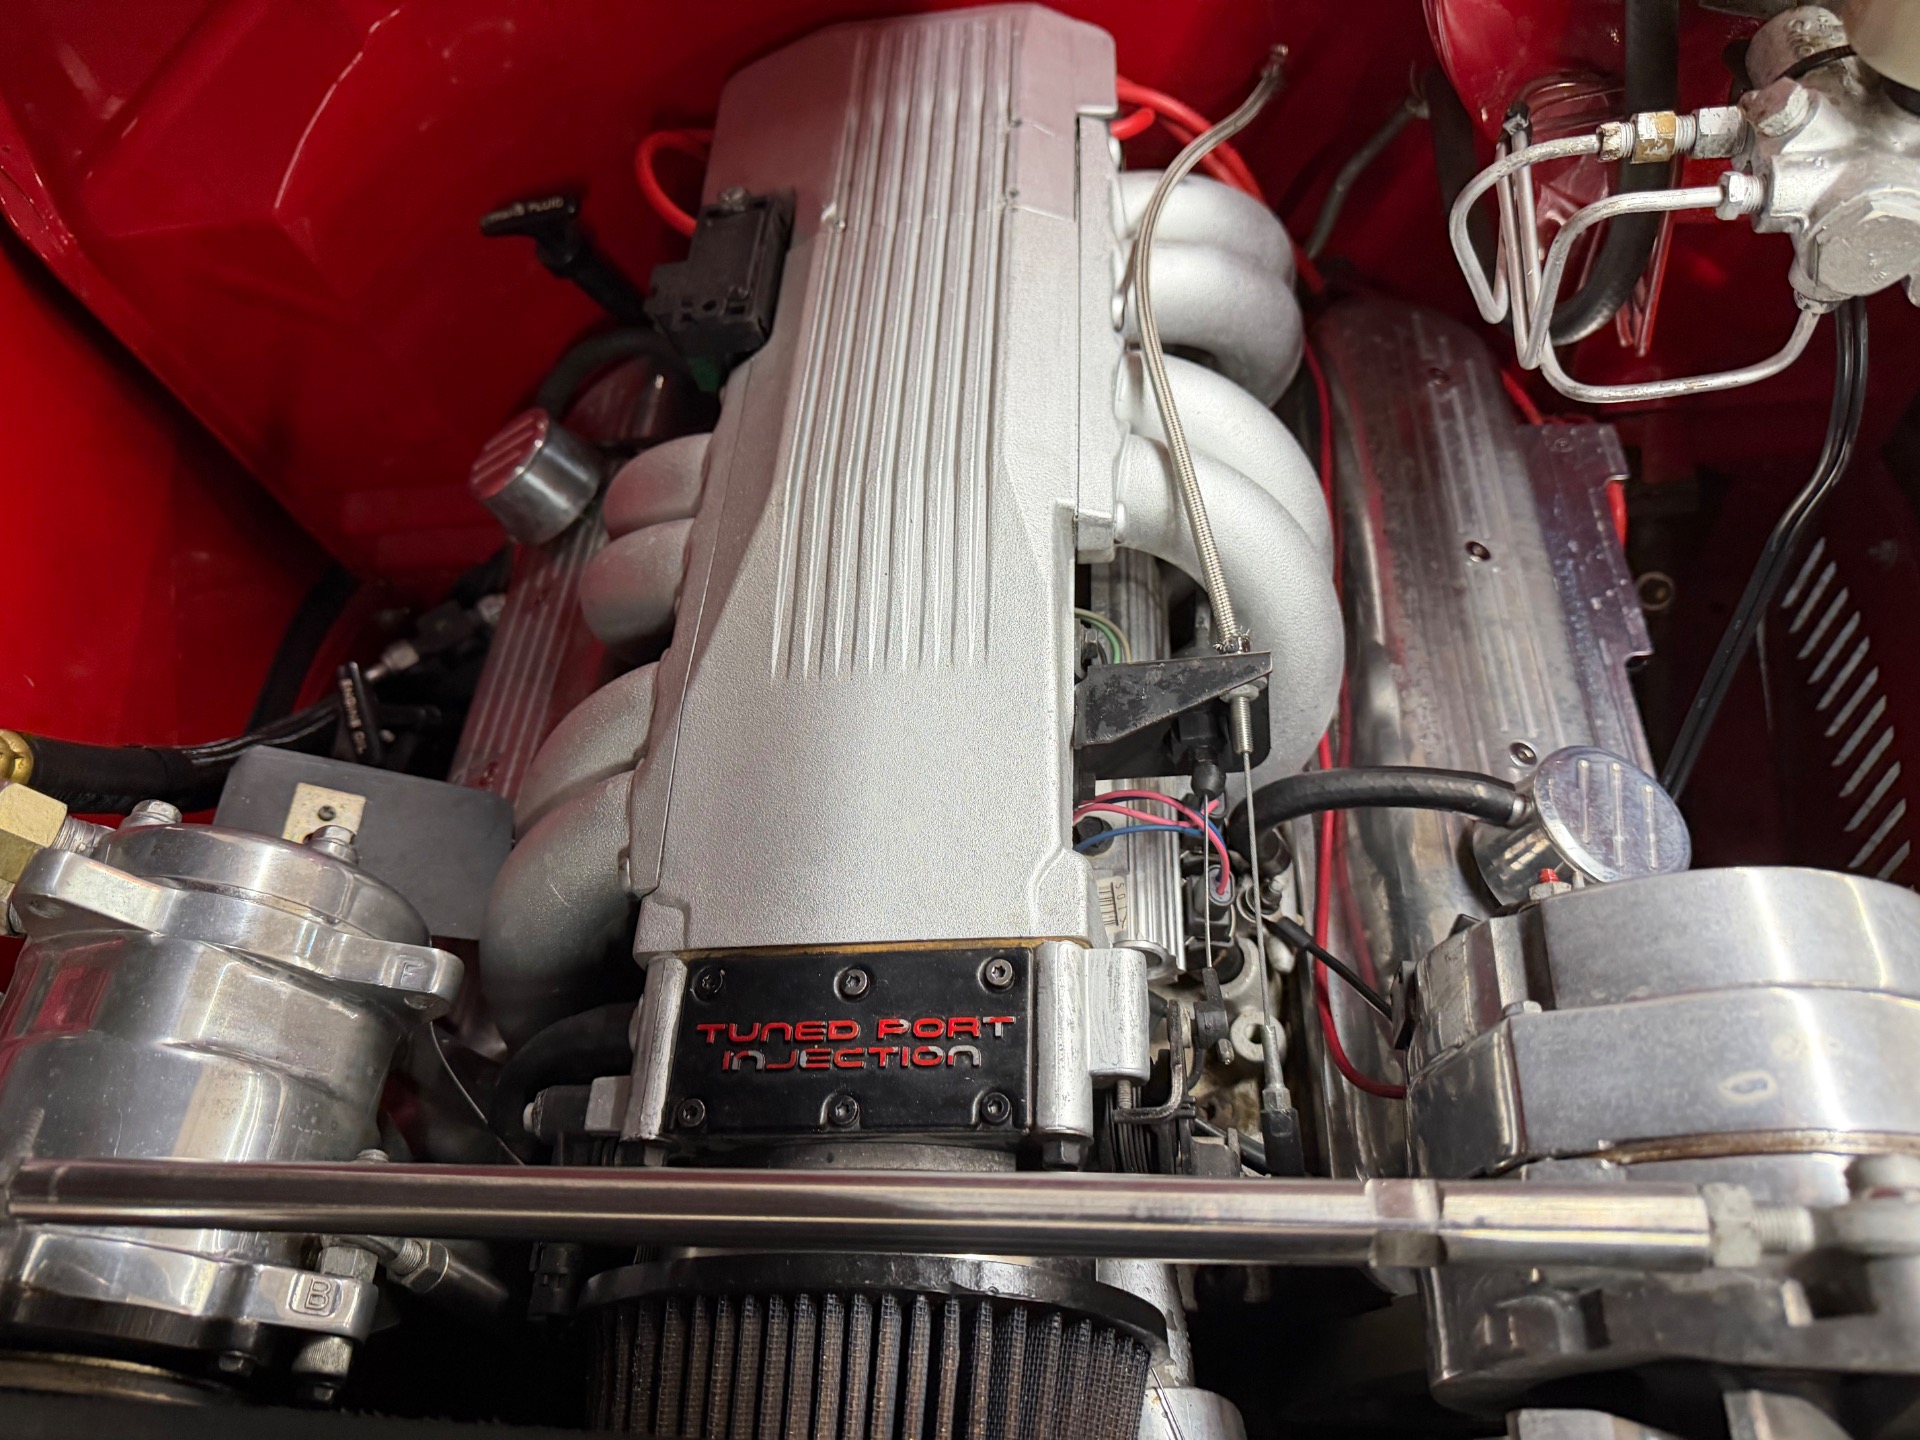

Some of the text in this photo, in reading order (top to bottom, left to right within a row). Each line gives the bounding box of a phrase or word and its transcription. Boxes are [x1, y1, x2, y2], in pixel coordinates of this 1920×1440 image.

[697, 1016, 1016, 1044] TUNED PORT
[722, 1044, 981, 1071] INJECTION
[304, 1278, 332, 1311] B
